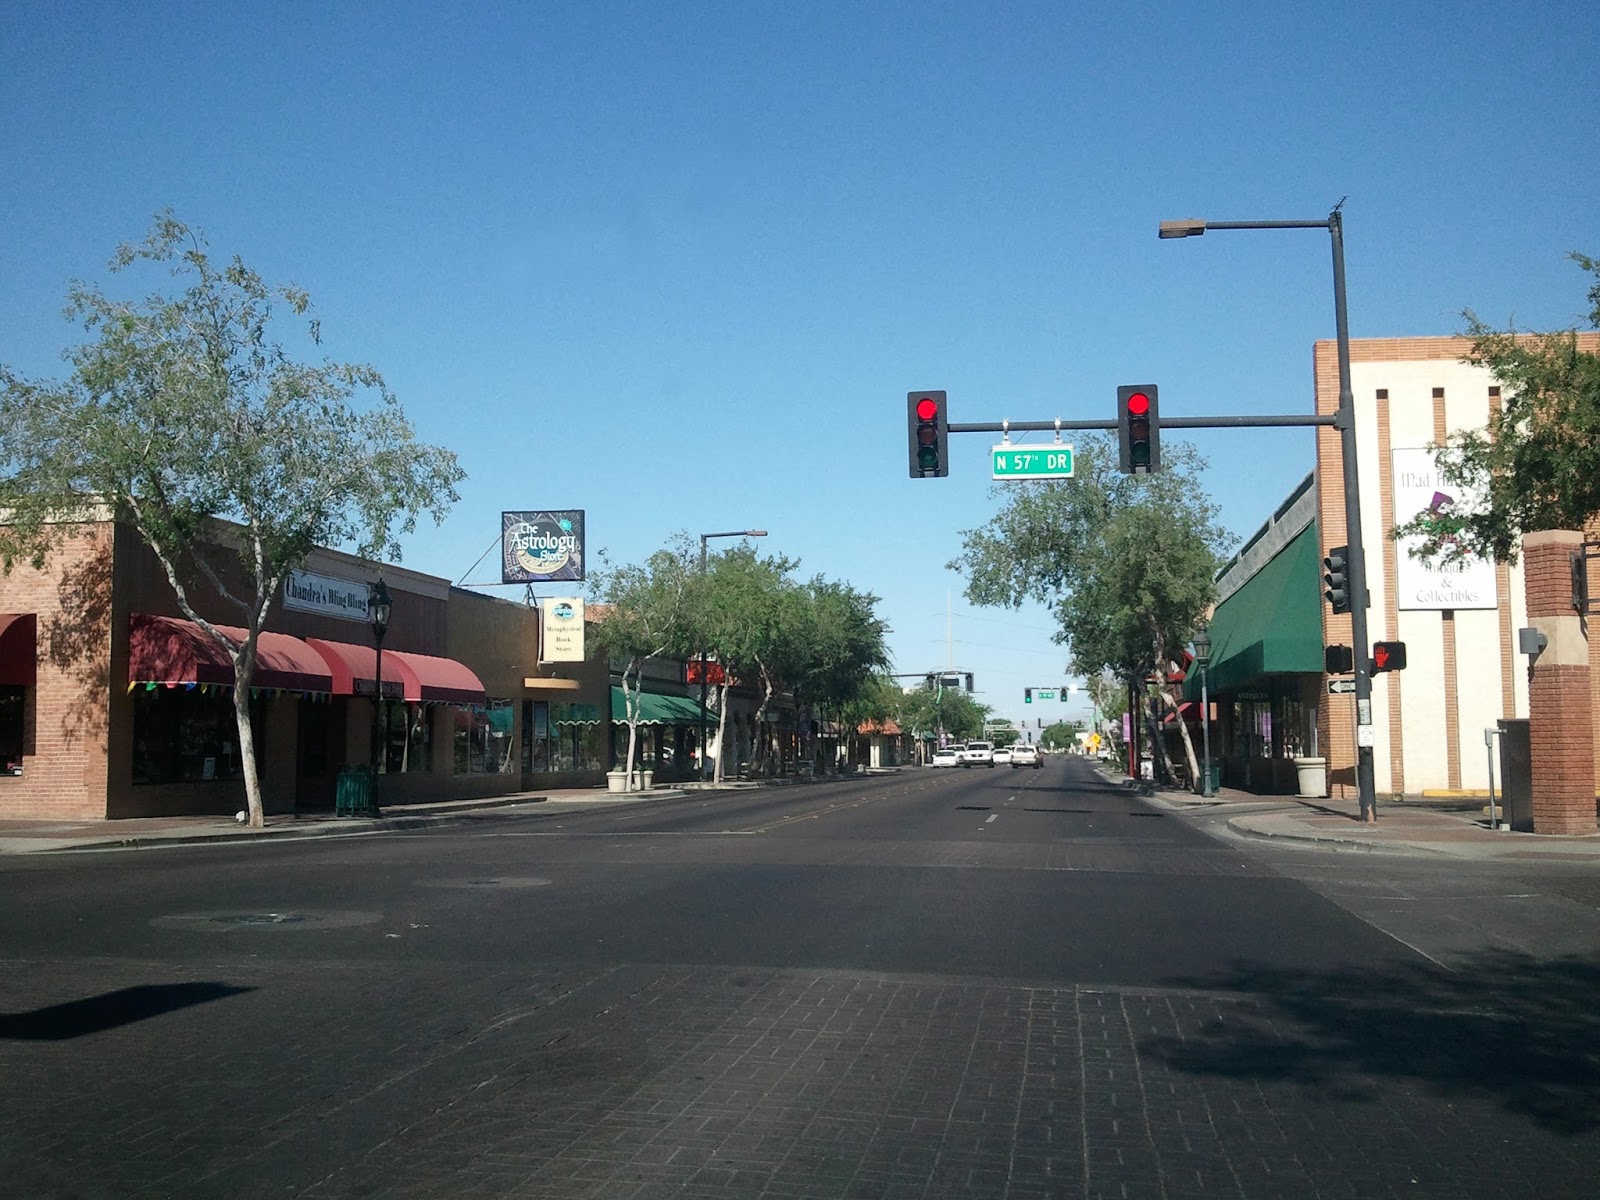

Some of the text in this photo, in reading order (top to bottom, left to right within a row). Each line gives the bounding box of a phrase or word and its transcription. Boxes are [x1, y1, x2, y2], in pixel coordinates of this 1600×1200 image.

[996, 455, 1007, 470] N
[1047, 453, 1067, 470] DR
[1401, 472, 1430, 488] Mad
[519, 522, 539, 536] The
[509, 531, 576, 555] Astrology
[540, 550, 565, 562] Store
[1441, 576, 1453, 588] &
[286, 576, 367, 612] Chandra's Bling Bling
[1416, 589, 1480, 603] Collectibles
